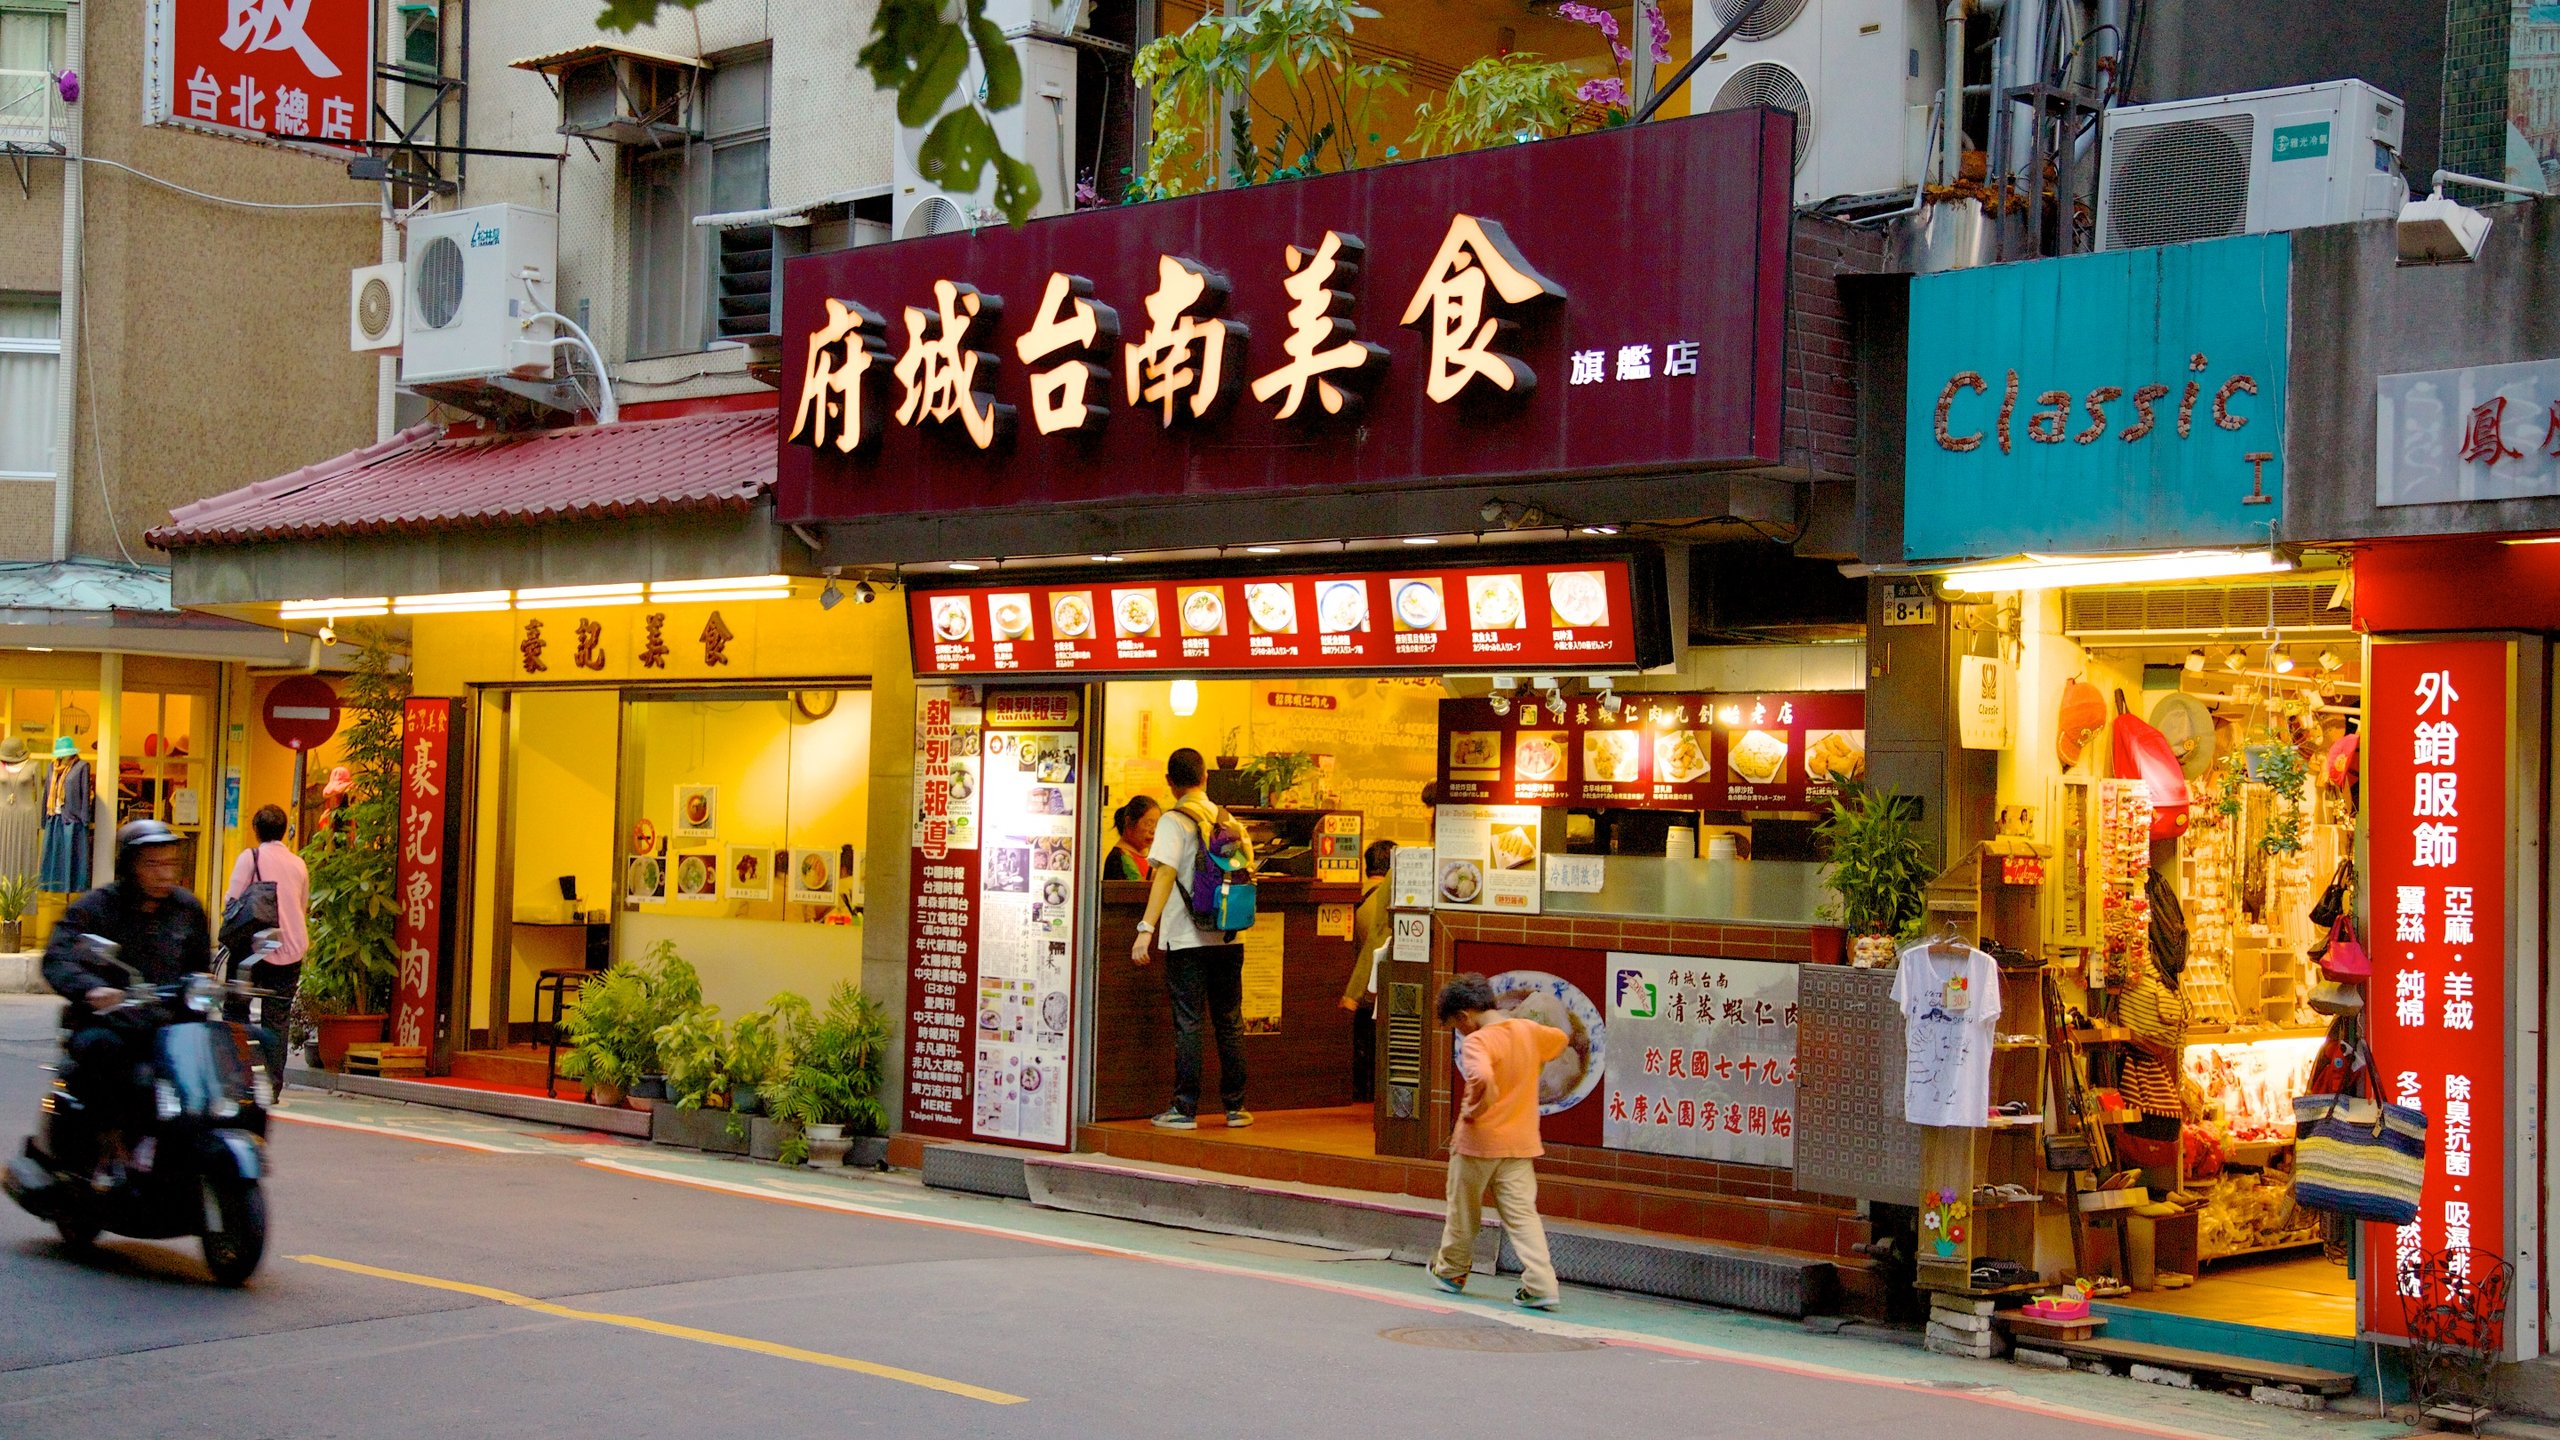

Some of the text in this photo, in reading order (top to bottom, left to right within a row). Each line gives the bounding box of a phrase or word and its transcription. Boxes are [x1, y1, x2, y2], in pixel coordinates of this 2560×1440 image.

[187, 65, 354, 149] 台北總店
[789, 213, 1566, 454] 府城台南美食
[1570, 340, 1700, 386] 旗艦店
[1934, 352, 2258, 454] Classic
[520, 610, 733, 674] 豪記美食
[406, 708, 447, 735] 台灣美食
[996, 696, 1068, 721] 熱烈報導
[922, 698, 951, 859] 熱烈報導
[2412, 669, 2460, 869] 外銷服飾
[397, 737, 439, 1047] 豪記魯肉飯
[917, 896, 969, 911] 東森新聞台
[916, 911, 968, 926] 三立電視台
[915, 938, 968, 954] 年代新聞台
[1667, 969, 1729, 988] 府城台南
[913, 1011, 965, 1027] 中天新聞台
[1667, 993, 1799, 1027] 清蒸蝦仁肉
[909, 1110, 963, 1124] Taipei Walker
[920, 1099, 952, 1112] HERE
[1608, 1091, 1792, 1137] 永康公園旁邊開始
